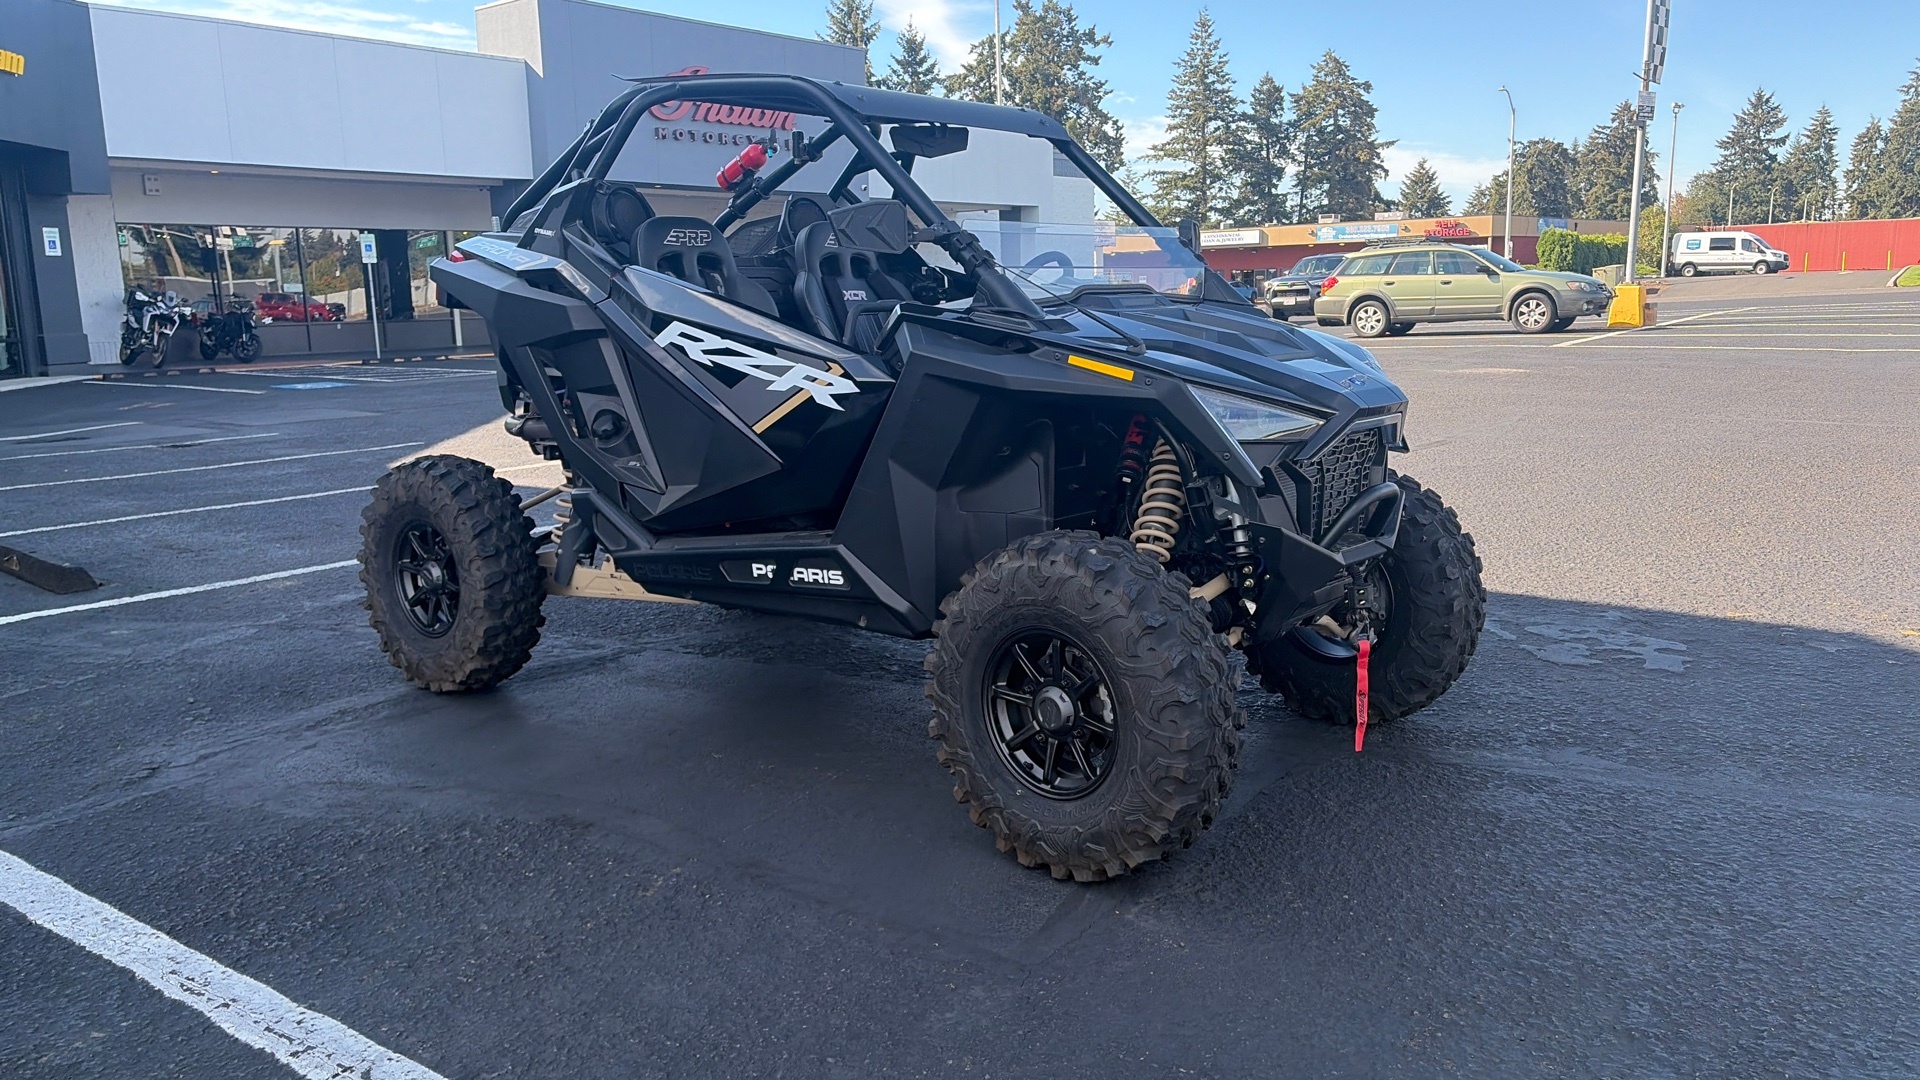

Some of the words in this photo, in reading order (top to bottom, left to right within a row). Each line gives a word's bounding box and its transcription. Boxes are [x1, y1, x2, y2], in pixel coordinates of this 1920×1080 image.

[654, 127, 795, 151] MOTORCY
[1435, 219, 1458, 228] SELF
[1424, 227, 1470, 237] STORAGE
[471, 241, 510, 256] PRO
[842, 290, 869, 302] XCR
[654, 320, 860, 412] RZR
[751, 563, 844, 585] PARIS
